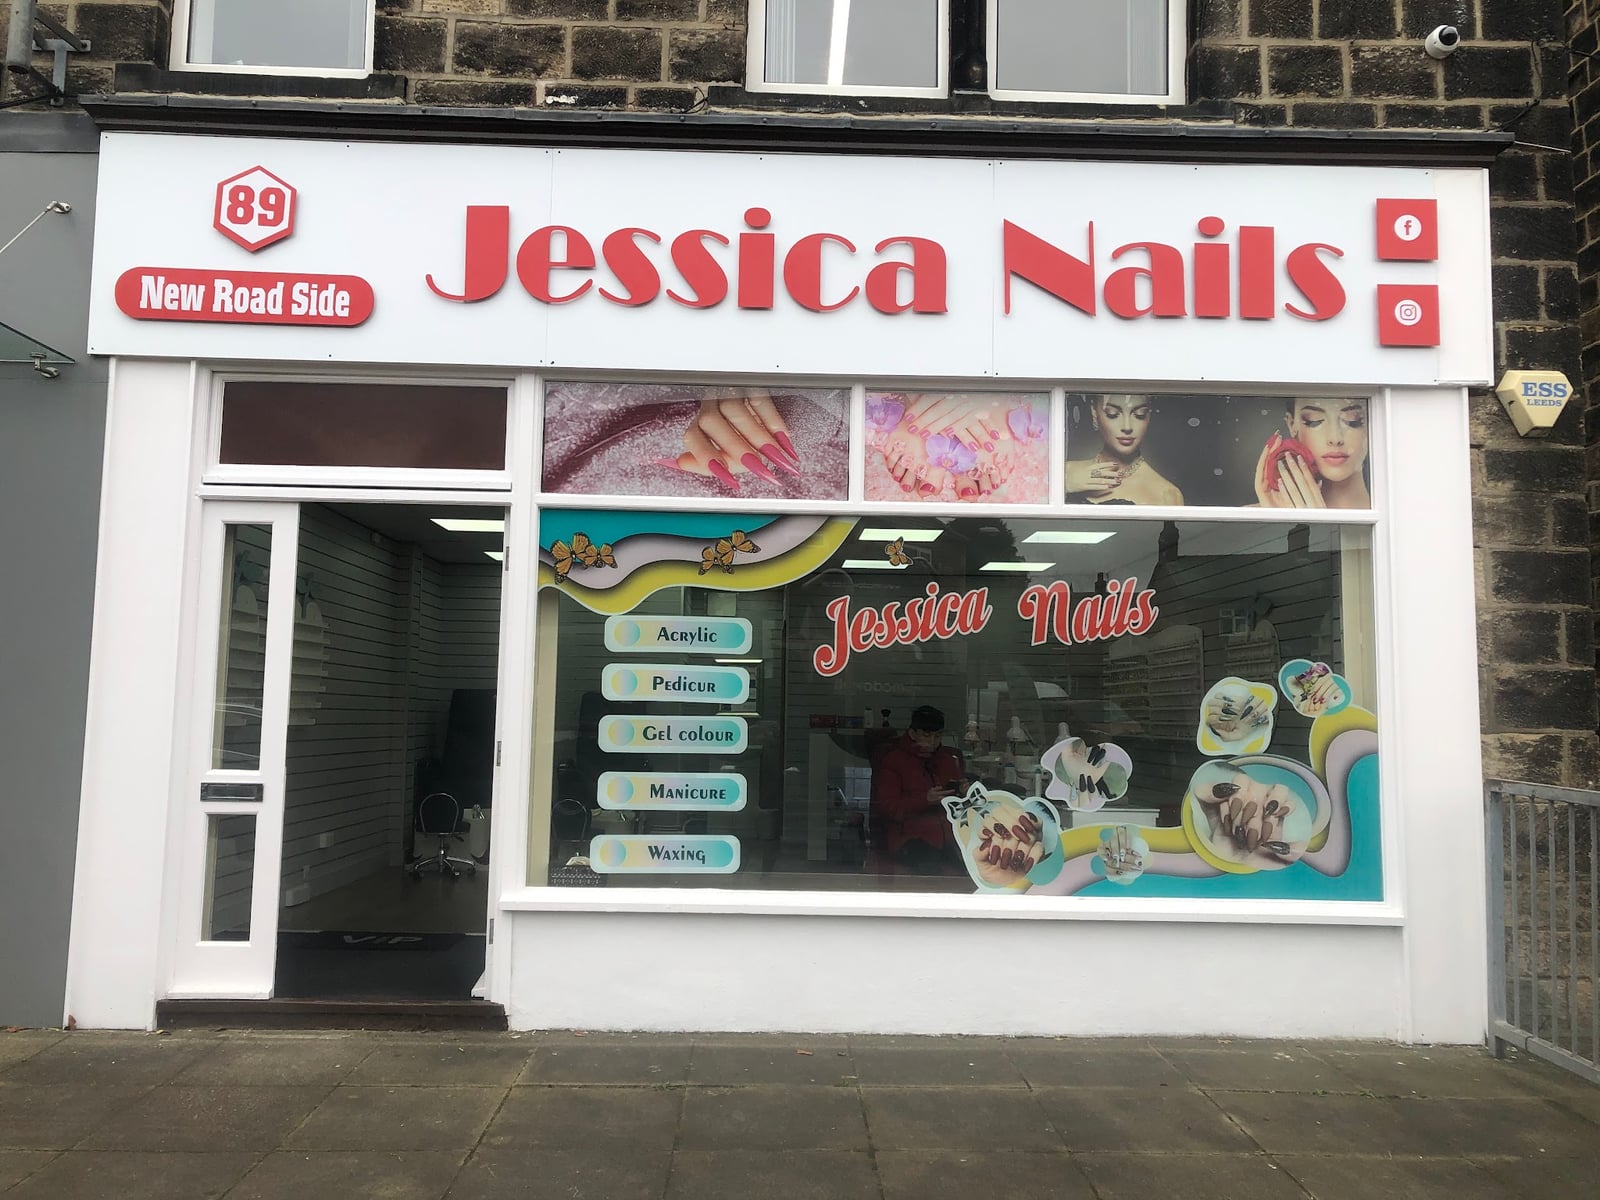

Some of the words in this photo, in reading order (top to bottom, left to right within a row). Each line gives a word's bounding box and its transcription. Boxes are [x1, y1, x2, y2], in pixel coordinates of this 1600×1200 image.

[226, 184, 287, 227] 89
[426, 206, 948, 315] Jessica
[1003, 216, 1347, 321] Nails
[139, 275, 205, 312] New
[212, 278, 285, 315] Road
[291, 281, 350, 317] Side
[1521, 382, 1568, 398] ESS
[1526, 398, 1562, 407] LEEDS
[812, 581, 993, 678] Jessica
[1017, 576, 1160, 646] Nails
